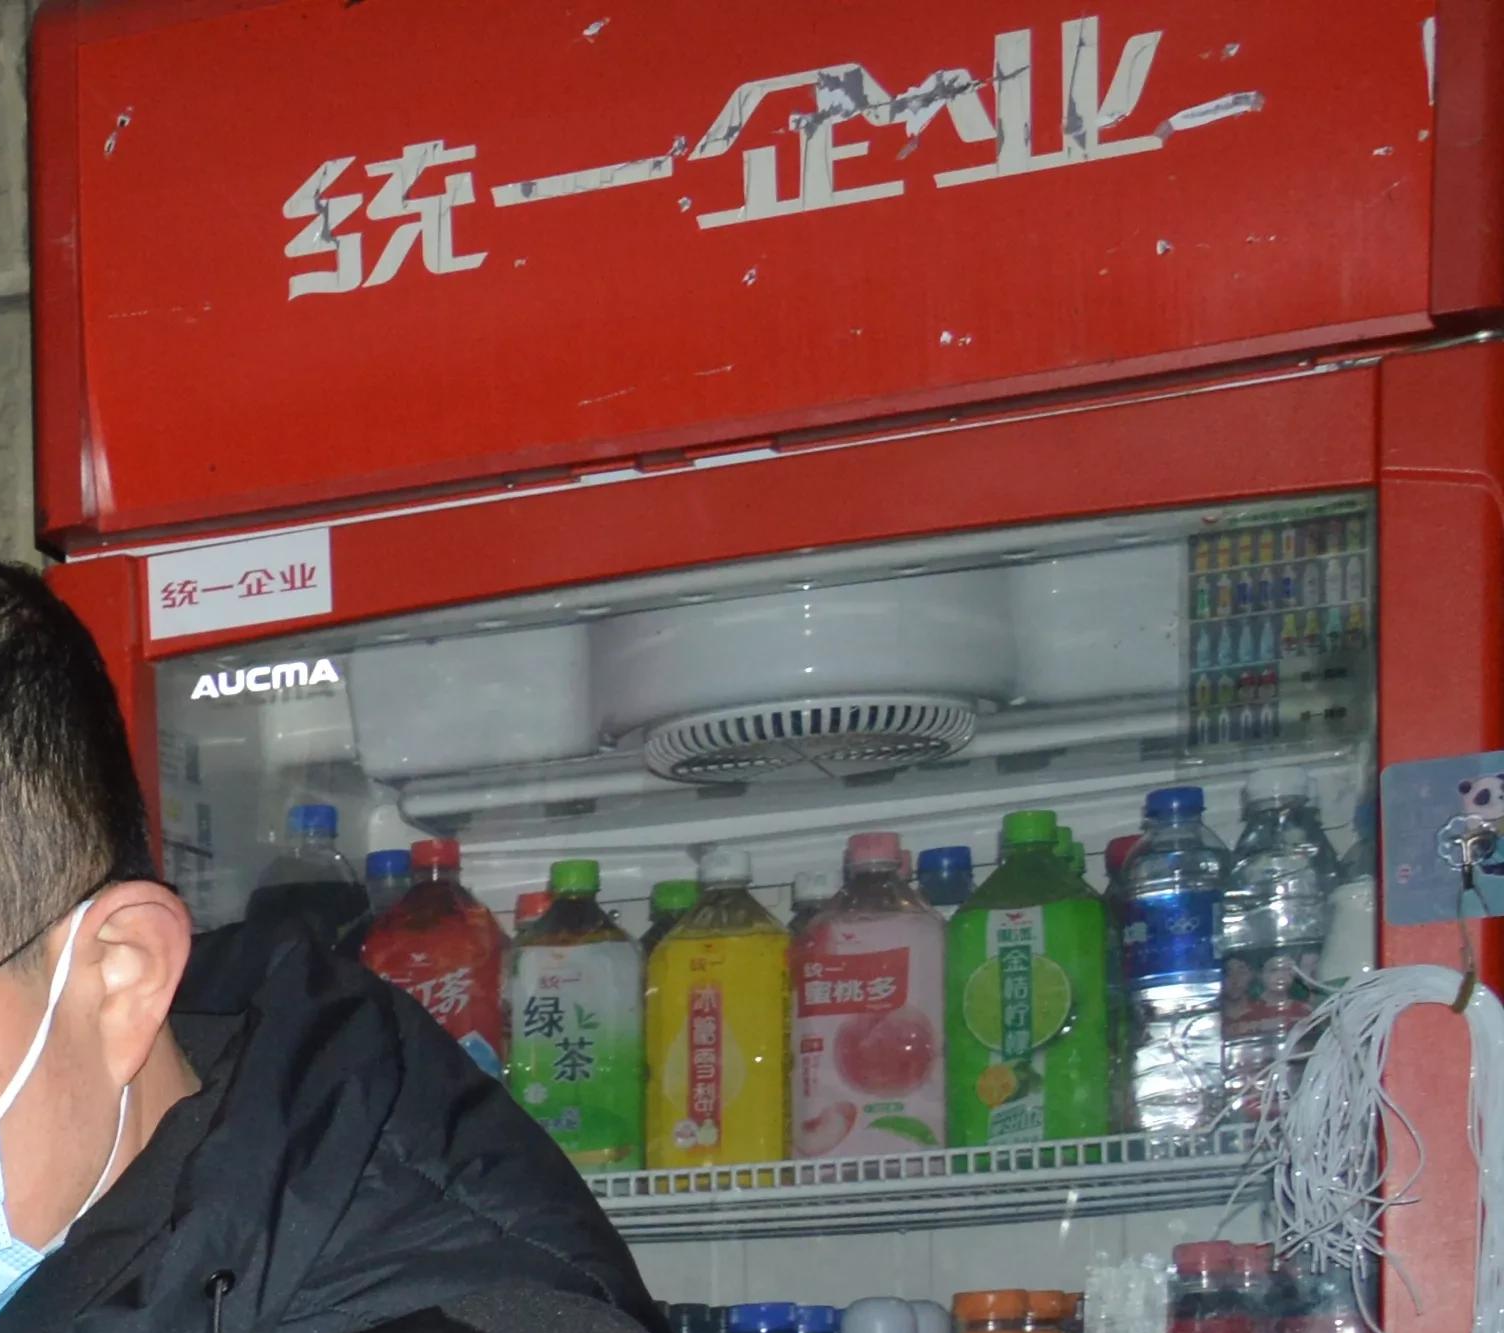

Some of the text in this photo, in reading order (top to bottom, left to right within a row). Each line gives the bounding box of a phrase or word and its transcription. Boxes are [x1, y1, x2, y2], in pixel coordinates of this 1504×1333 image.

[283, 15, 1265, 300] 统一企业
[161, 562, 318, 611] 统一企业
[190, 657, 339, 702] AUCMA
[804, 977, 897, 1007] 蜜桃多
[1001, 948, 1033, 1058] 金桔柠檬
[524, 996, 594, 1082] 绿茶
[691, 986, 721, 1112] 冰糖雪梨
